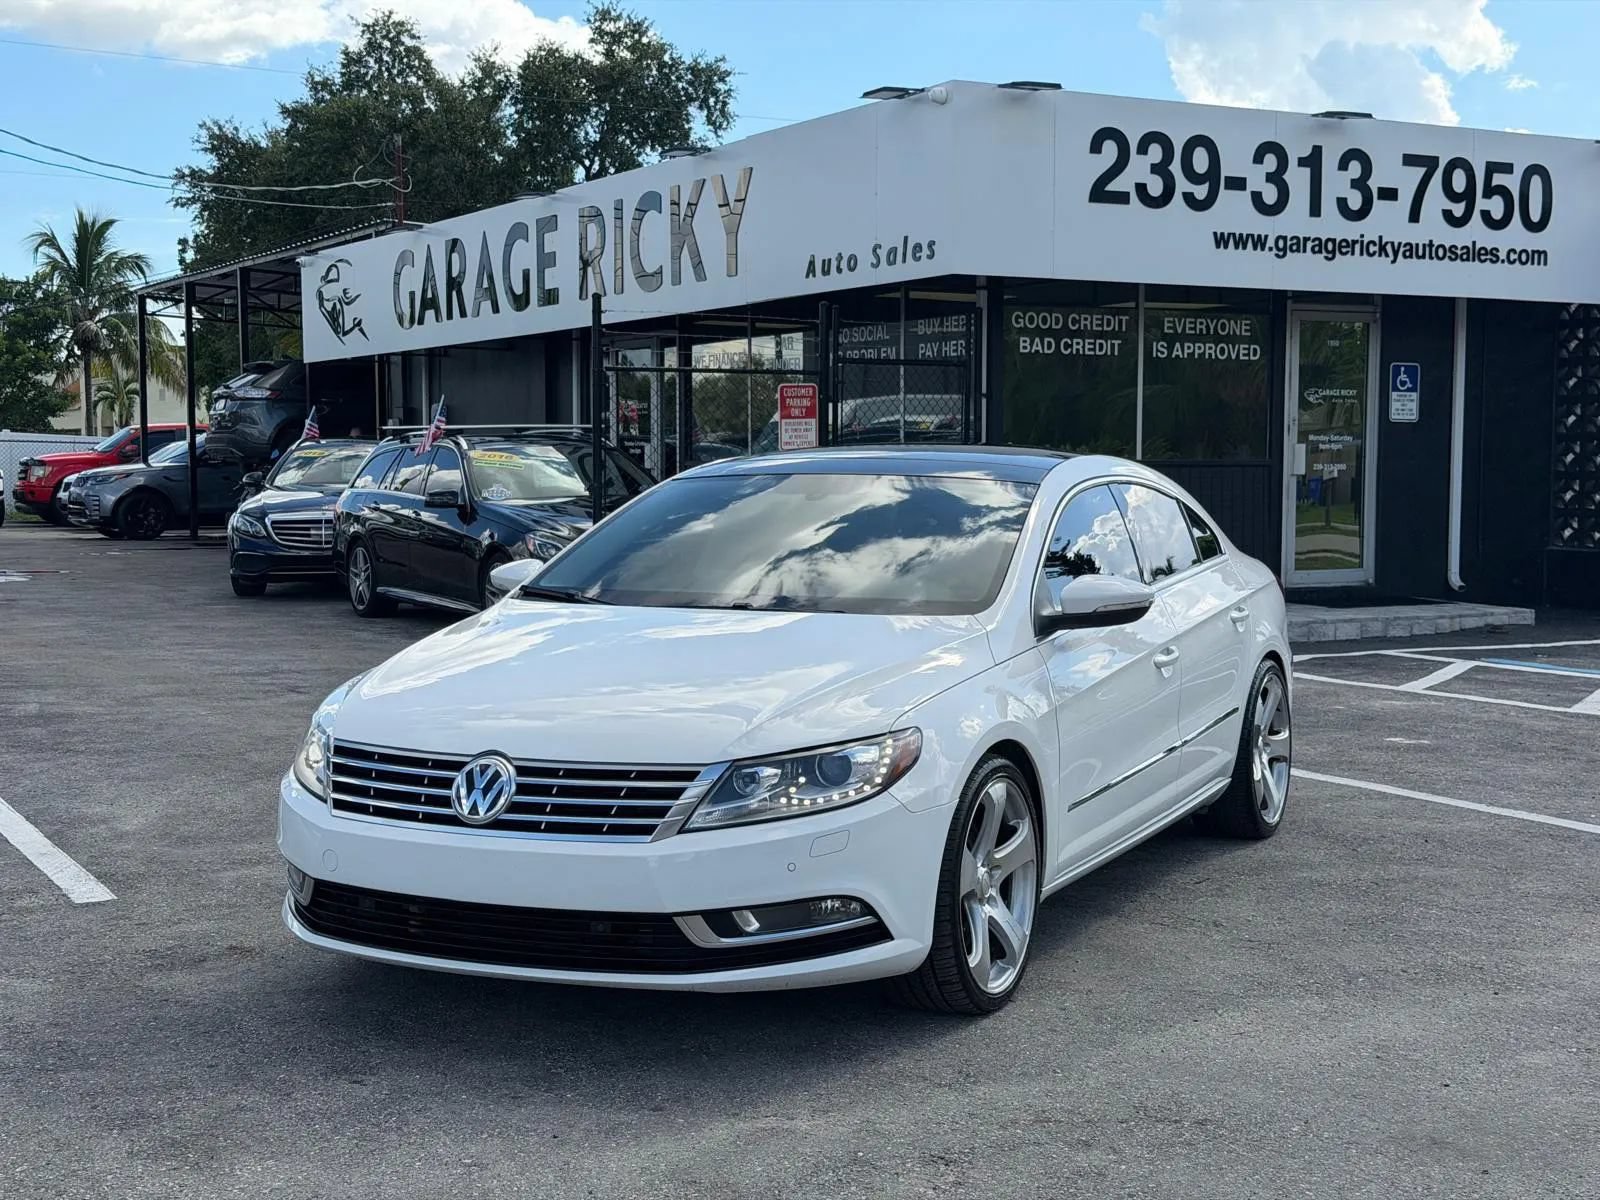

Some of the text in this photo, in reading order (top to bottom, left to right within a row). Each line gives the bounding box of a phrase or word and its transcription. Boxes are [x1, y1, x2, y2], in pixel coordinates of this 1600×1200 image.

[1088, 127, 1553, 233] 239-313-7950
[393, 167, 753, 330] GARAGE RICKY
[805, 235, 936, 279] Auto Sales
[1213, 230, 1548, 267] www.garagerickyautosales.com
[918, 318, 941, 335] BUY
[1011, 311, 1130, 332] GOOD CREDIT
[1164, 317, 1251, 336] EVERYONE
[852, 324, 890, 342] SOCIAL
[919, 341, 940, 359] PAY
[1019, 337, 1121, 356] BAD CREDIT
[1152, 342, 1261, 361] IS APPROVED
[783, 387, 814, 397] CUSTOMER
[785, 397, 811, 407] PARKING
[790, 407, 806, 417] ONLY
